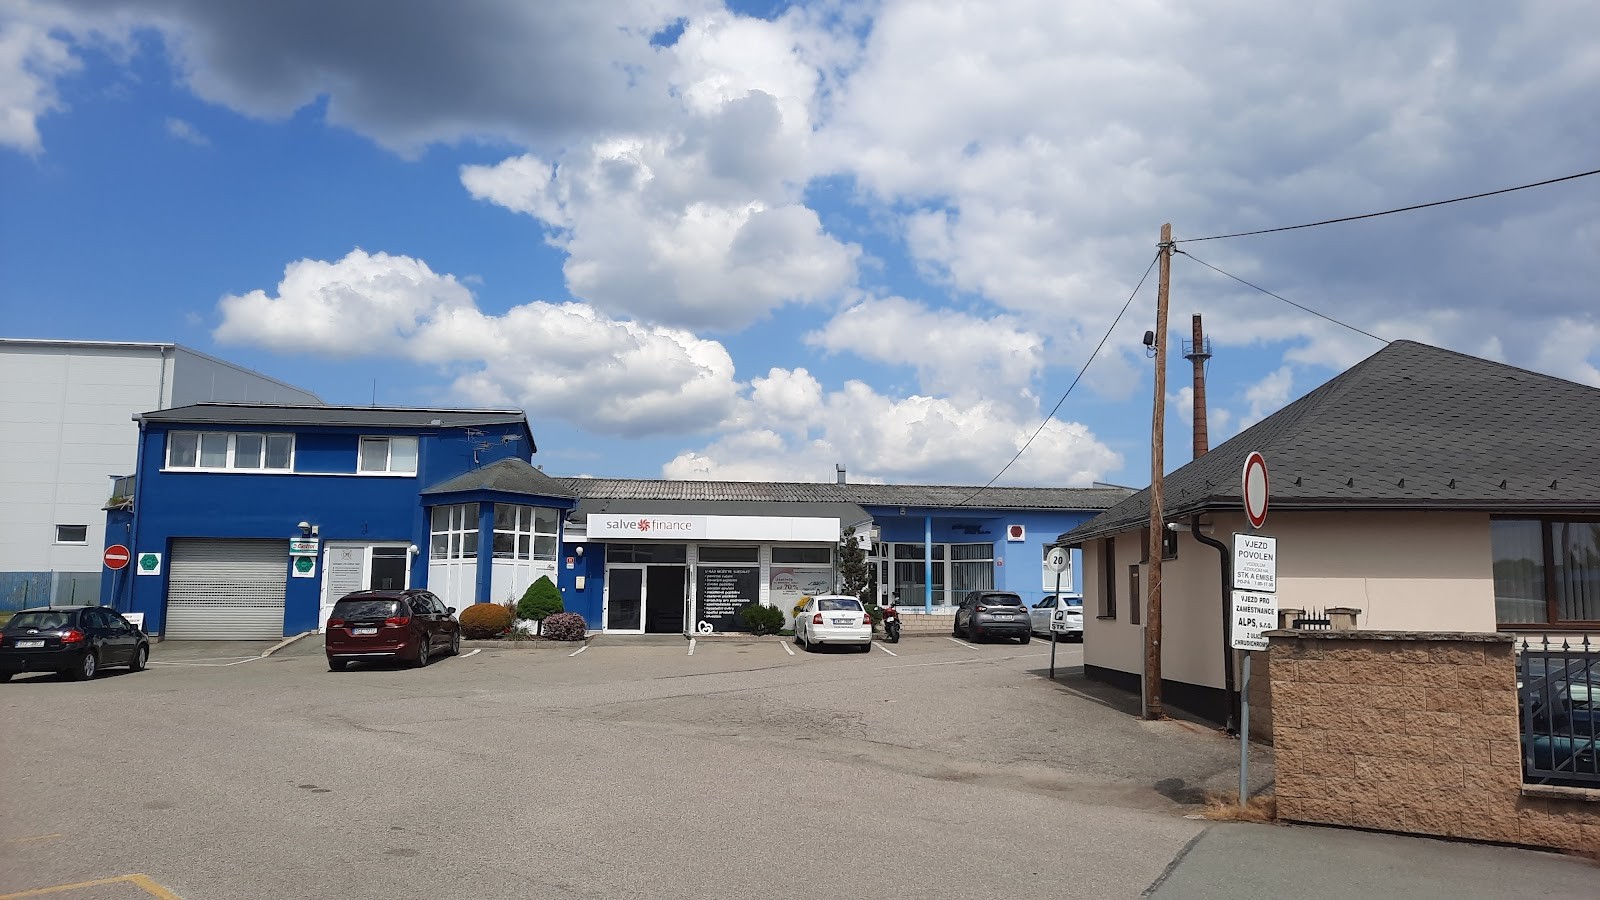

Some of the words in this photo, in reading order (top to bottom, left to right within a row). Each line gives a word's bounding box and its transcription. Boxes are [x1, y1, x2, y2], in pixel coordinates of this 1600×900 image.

[606, 519, 637, 529] salve
[652, 519, 692, 532] finance
[1245, 540, 1268, 549] VJEZD
[1053, 555, 1063, 565] 20
[1238, 550, 1274, 561] POVOLEN
[1237, 571, 1249, 579] STK
[1256, 573, 1274, 582] EMISE
[1241, 595, 1258, 603] VJEZD
[1238, 617, 1258, 629] ALPS,
